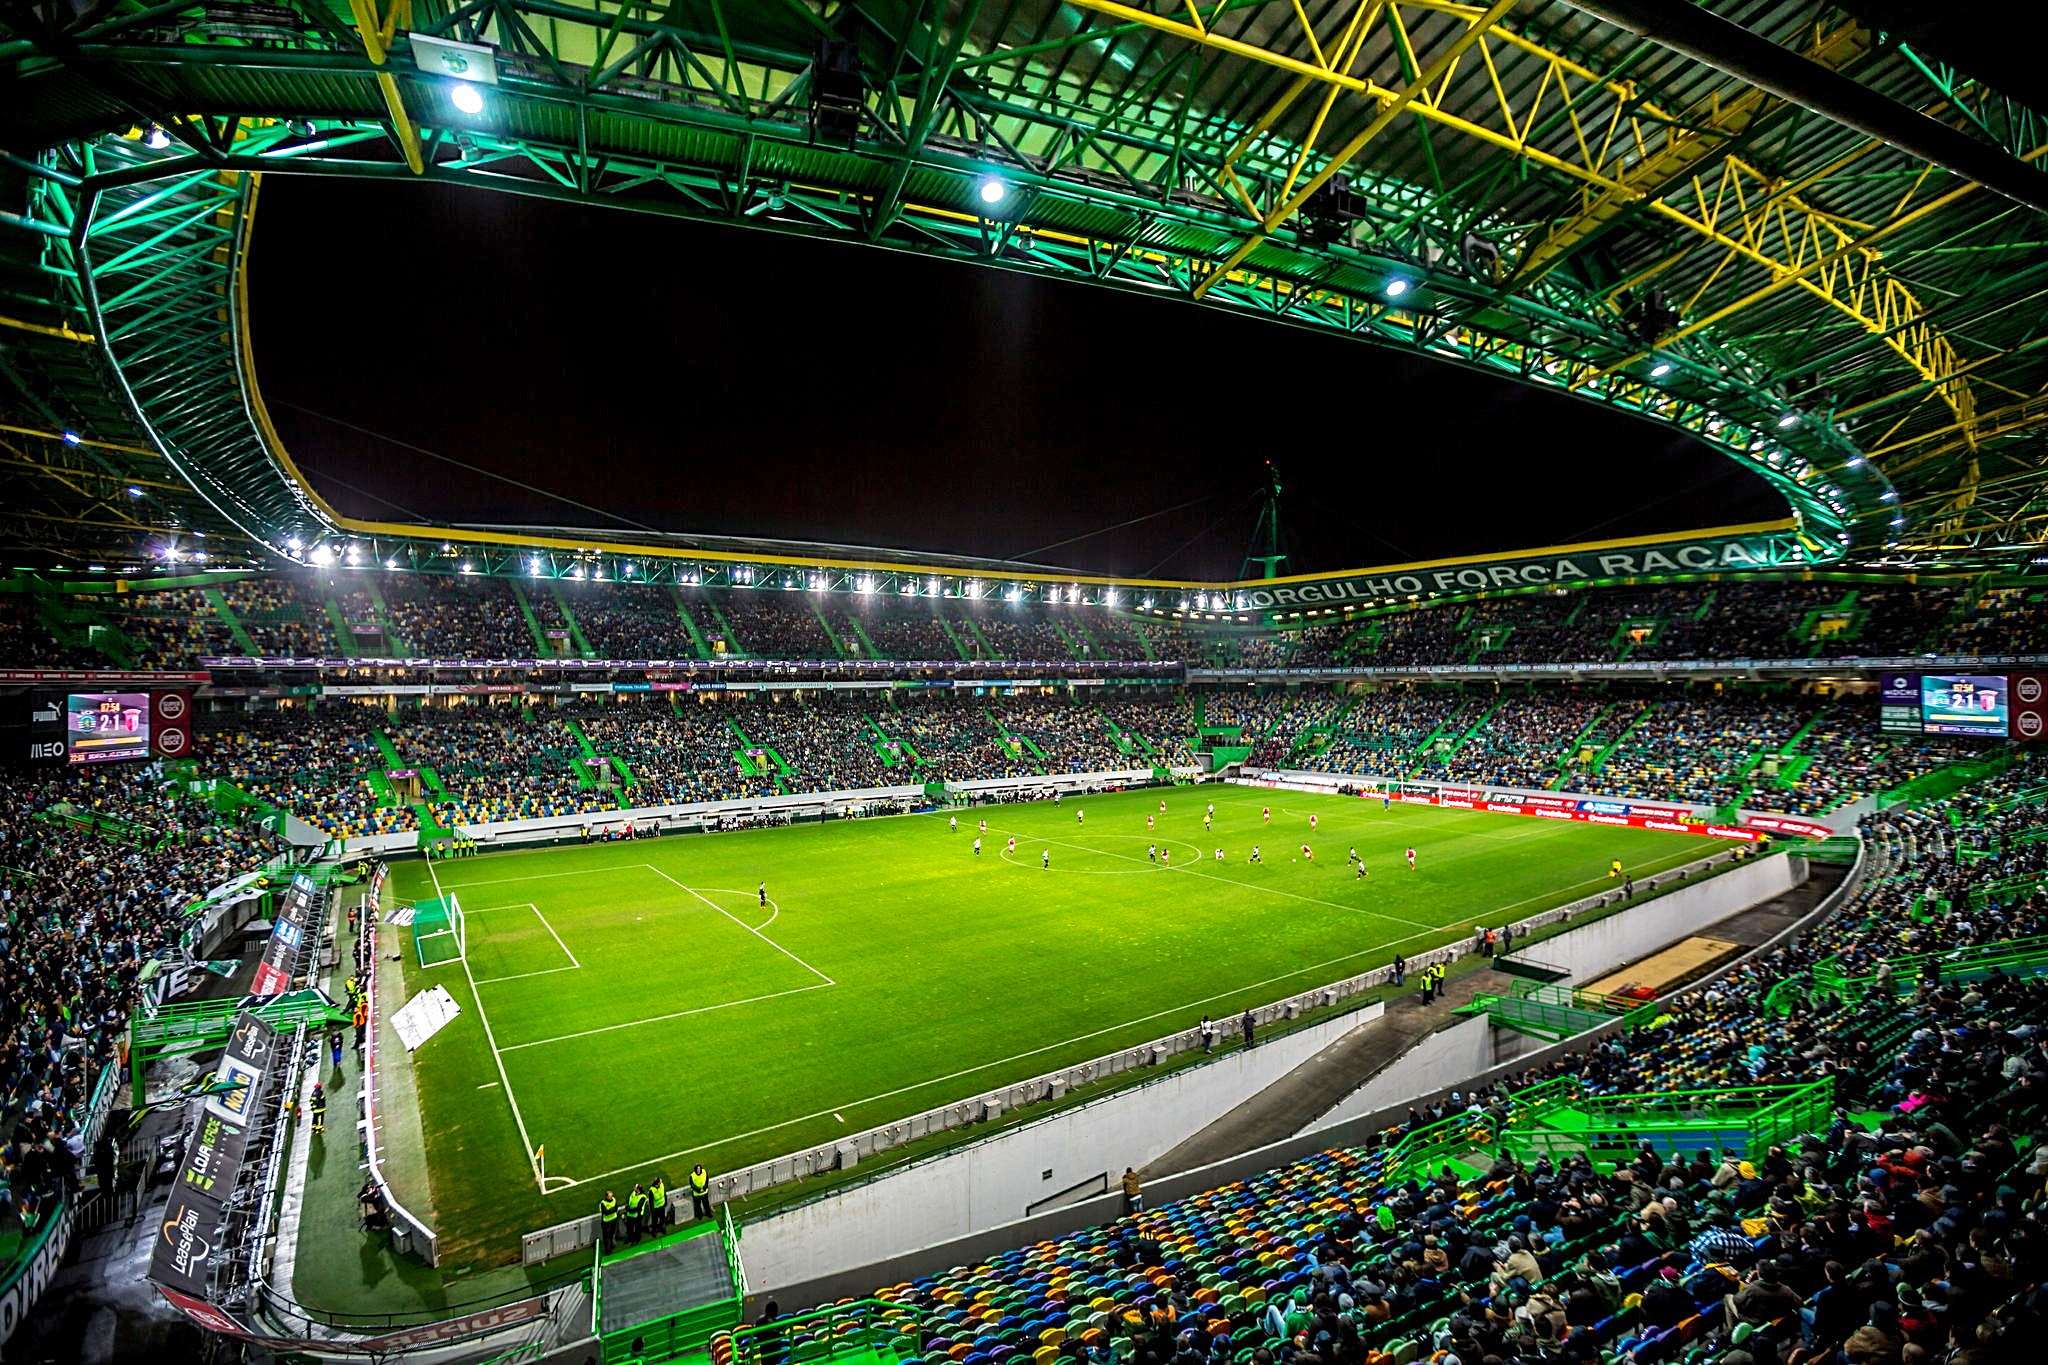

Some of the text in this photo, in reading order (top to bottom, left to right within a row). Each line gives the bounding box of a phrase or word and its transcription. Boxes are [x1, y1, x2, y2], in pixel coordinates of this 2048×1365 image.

[1251, 575, 1422, 606] ORGULHO
[31, 741, 64, 759] MEO
[1493, 805, 1521, 814] vodafone
[1594, 814, 1629, 825] vodafone
[1653, 821, 1689, 832] vodafone
[1715, 827, 1754, 839] vodafone
[240, 1025, 260, 1058] LeasePlan
[170, 1208, 200, 1275] LeasePlan
